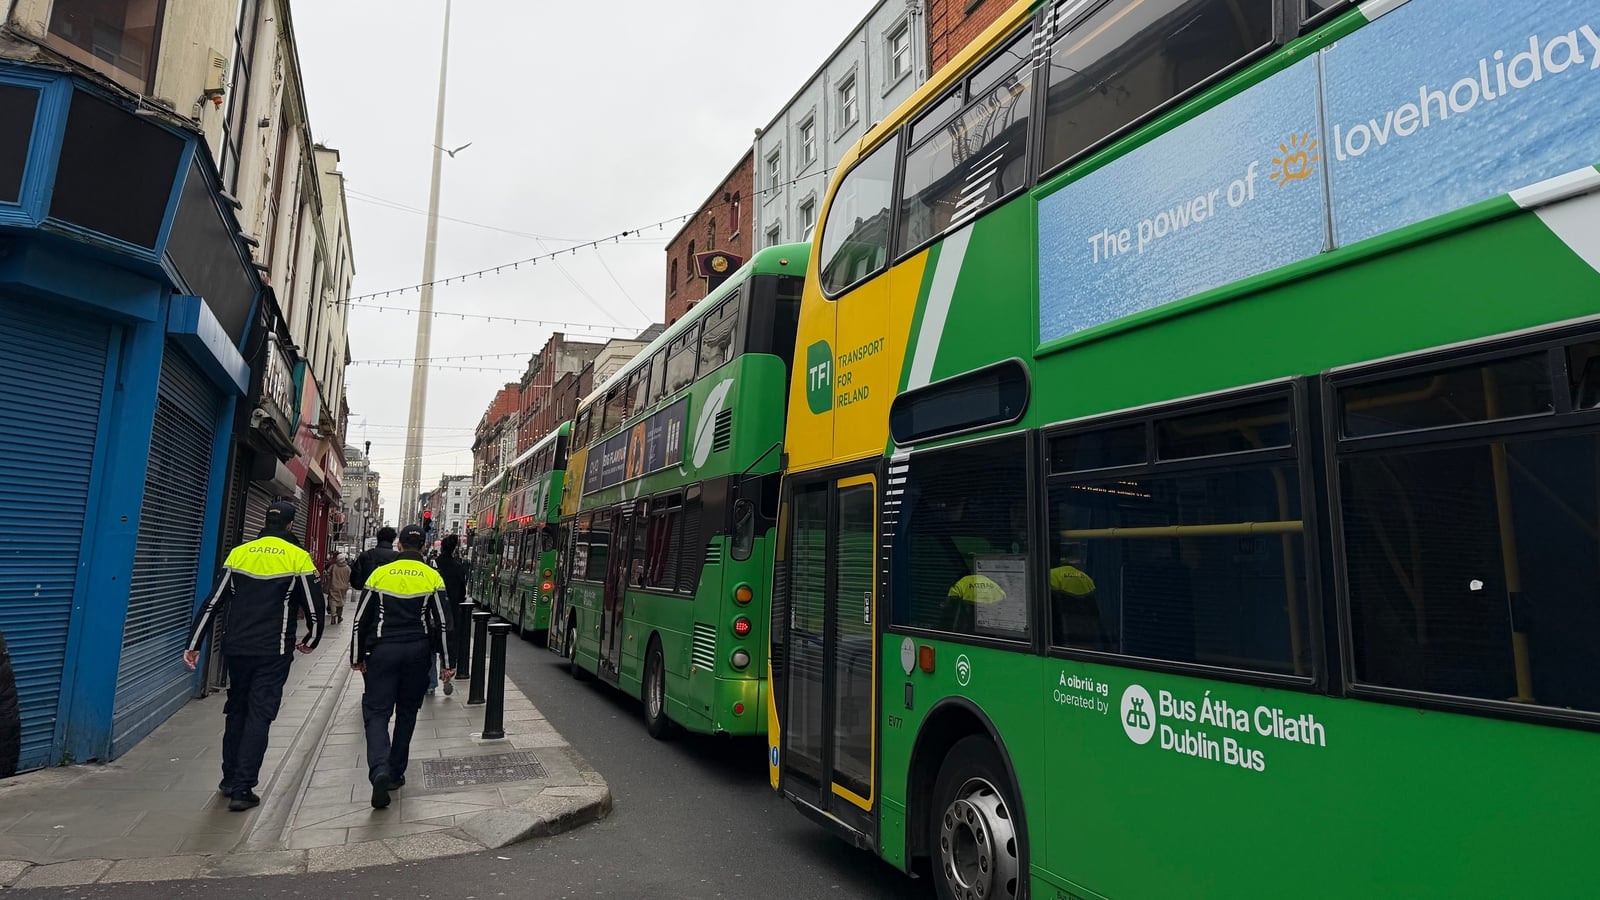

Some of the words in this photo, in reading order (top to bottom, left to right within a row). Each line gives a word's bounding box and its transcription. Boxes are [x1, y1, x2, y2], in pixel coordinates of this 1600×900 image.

[1088, 228, 1131, 264] The
[1138, 188, 1220, 255] power
[1227, 160, 1259, 208] of
[838, 337, 885, 369] TRANSPORT
[809, 360, 831, 392] TFI
[837, 371, 852, 389] FOR
[836, 385, 870, 408] IRELAND
[248, 546, 287, 556] GARDA
[388, 568, 425, 578] GARDA
[1059, 670, 1067, 686] Á
[1067, 676, 1094, 692] oibriú
[1096, 680, 1109, 697] ag
[1053, 689, 1095, 711] Operated
[1097, 695, 1109, 715] by
[1159, 690, 1197, 722] Bus
[1199, 690, 1250, 732] Átha
[1253, 705, 1327, 747] Cliath
[1160, 724, 1221, 762] Dublin
[1223, 737, 1266, 772] Bus
